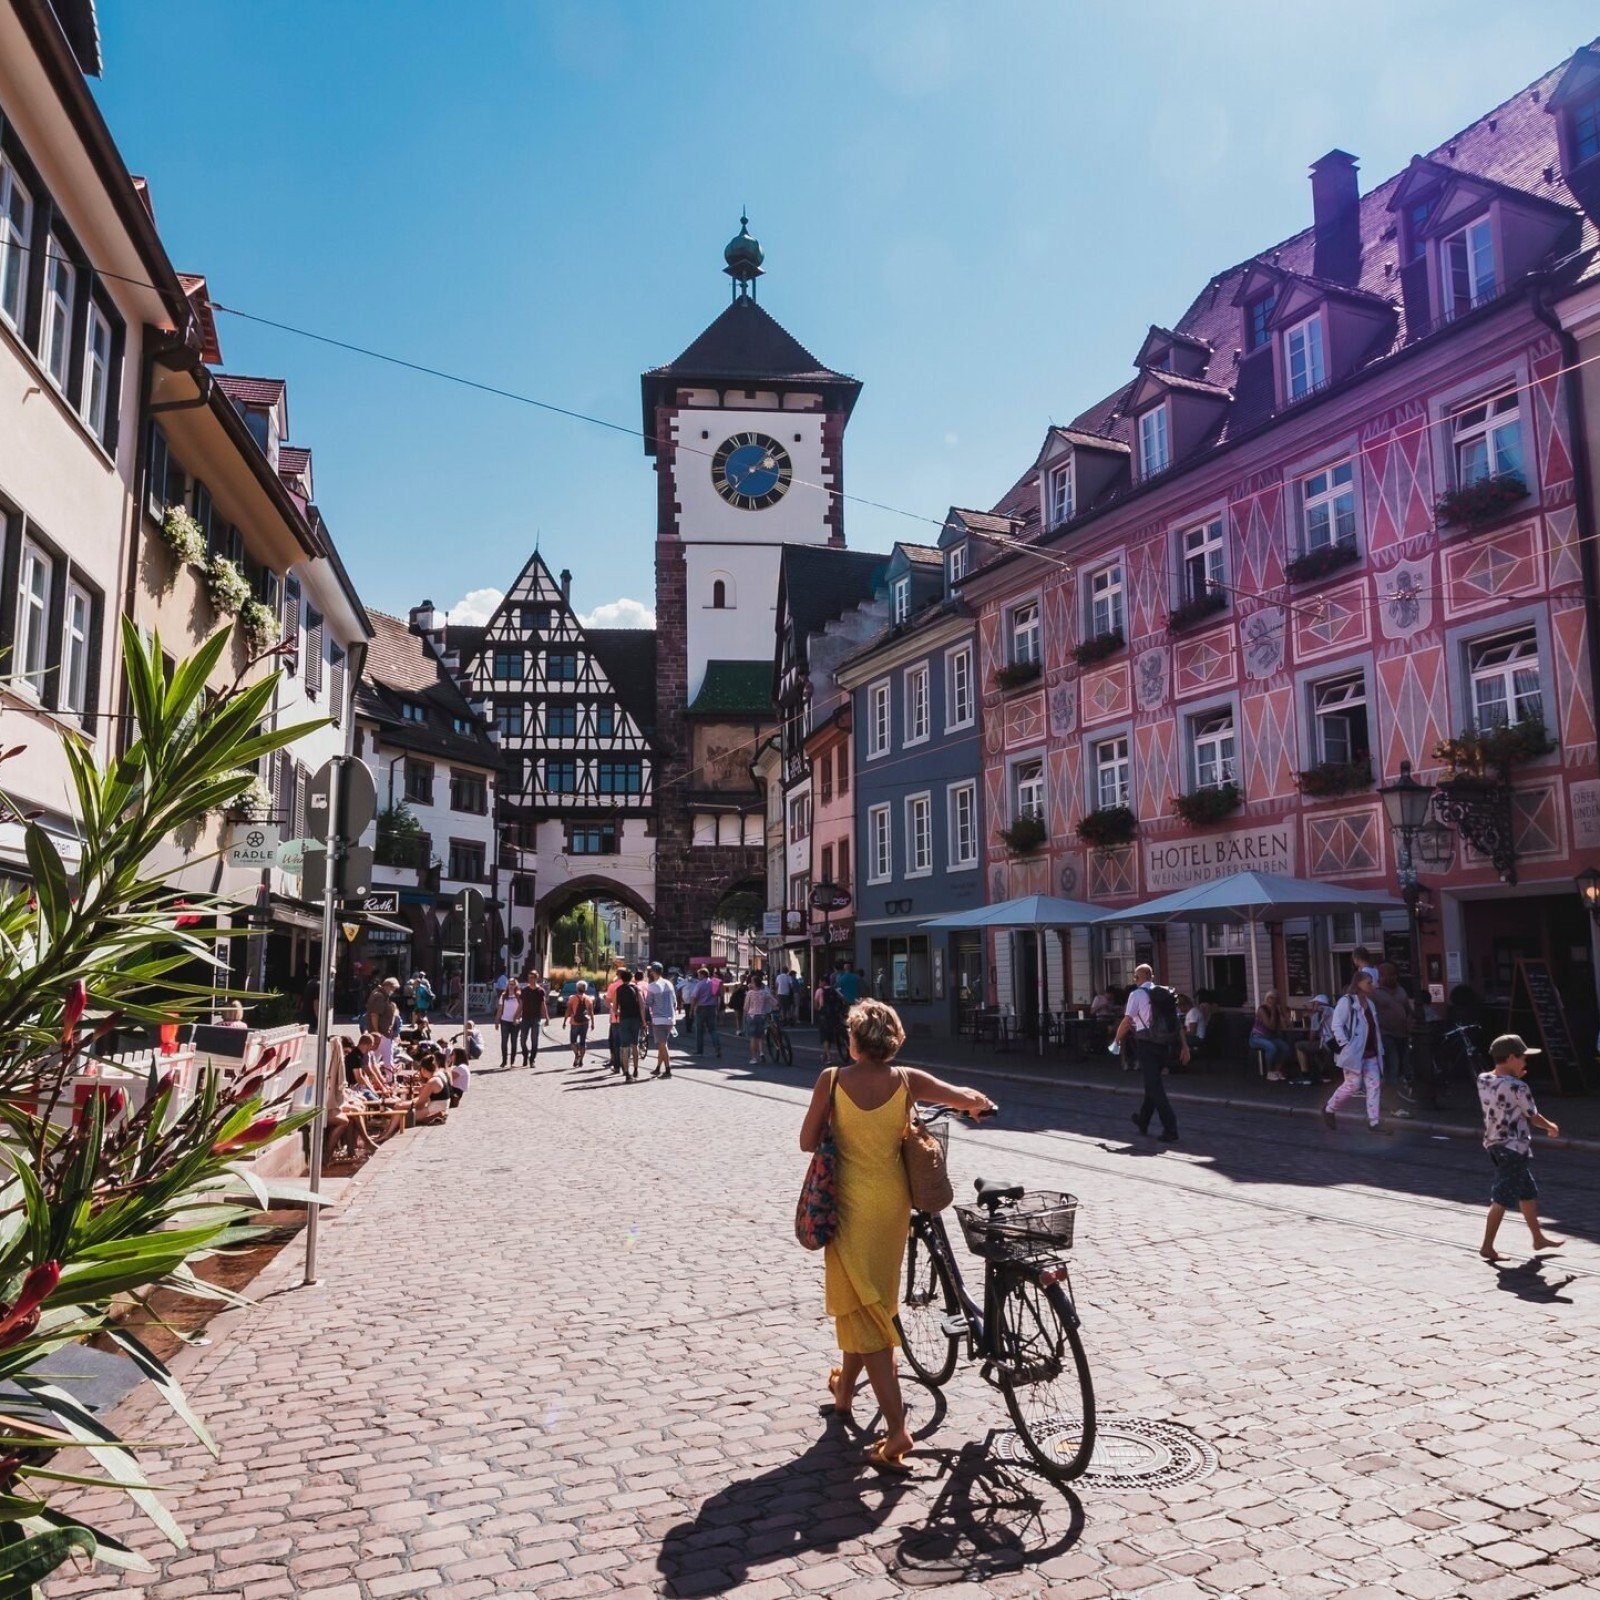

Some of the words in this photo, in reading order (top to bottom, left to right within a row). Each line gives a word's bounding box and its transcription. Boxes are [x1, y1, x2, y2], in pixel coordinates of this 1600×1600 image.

[233, 848, 274, 860] RÄDLE
[1151, 842, 1211, 871] HOTEL
[1215, 832, 1288, 863] BÄREN
[363, 897, 393, 912] Rath
